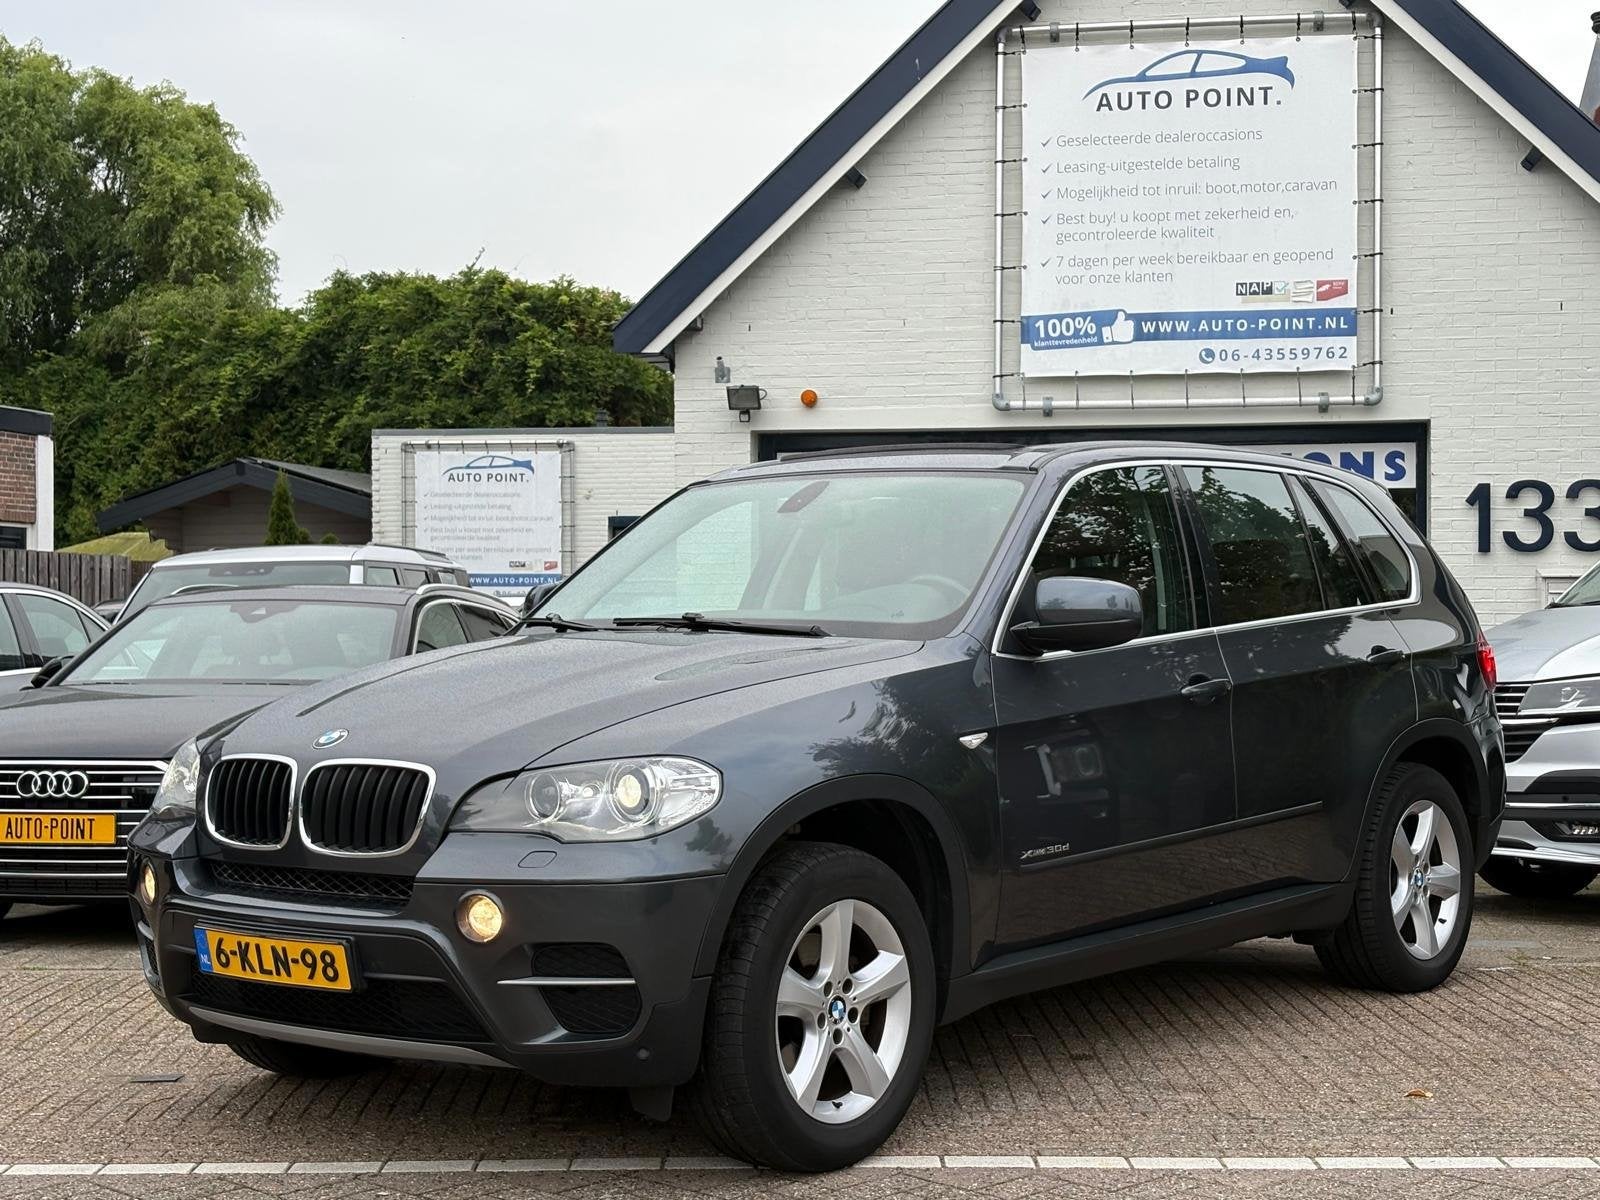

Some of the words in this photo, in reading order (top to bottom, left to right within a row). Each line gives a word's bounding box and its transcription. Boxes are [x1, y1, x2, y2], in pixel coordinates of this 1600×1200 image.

[1096, 90, 1173, 112] AUTO
[1185, 86, 1282, 108] POINT.
[1056, 132, 1151, 148] Geselecteerde
[1155, 129, 1263, 144] dealeroccasions
[1056, 157, 1183, 175] Leasing-uitgestelde
[1187, 155, 1240, 171] betaling
[1056, 185, 1138, 201] Mogelijkheid
[1142, 185, 1161, 197] tot
[1165, 182, 1201, 196] inruil:
[1205, 179, 1337, 195] boot,motor,caravan
[1056, 213, 1085, 225] Best
[1089, 211, 1116, 227] buy!
[1120, 213, 1128, 223] u
[1133, 210, 1171, 224] koopt
[1175, 210, 1200, 221] met
[1204, 207, 1270, 220] zekerheid
[1274, 207, 1295, 220] en,
[1056, 227, 1157, 246] gecontroleerde
[1161, 225, 1215, 239] kwaliteit
[1056, 255, 1064, 268] 7
[1067, 255, 1109, 271] dagen
[1112, 256, 1134, 270] per
[1138, 252, 1173, 266] week
[1176, 250, 1248, 265] bereikbaar
[1252, 251, 1269, 263] en
[1273, 248, 1334, 265] geopend
[1056, 274, 1084, 285] voor
[1088, 273, 1120, 284] onze
[1124, 270, 1173, 283] klanten
[1237, 281, 1272, 295] NAP
[1034, 316, 1097, 338] 100%
[1141, 316, 1349, 333] WWW.AUTO-POINT.NL
[1034, 336, 1098, 347] klanttevredenheid
[1219, 346, 1348, 361] 06-43559762
[448, 473, 482, 482] AUTO
[487, 473, 529, 482] POINT.
[1465, 479, 1600, 553] 133
[5, 817, 96, 840] AUTO-POINT
[201, 953, 211, 965] NL
[215, 937, 339, 982] 6-KLN-98
